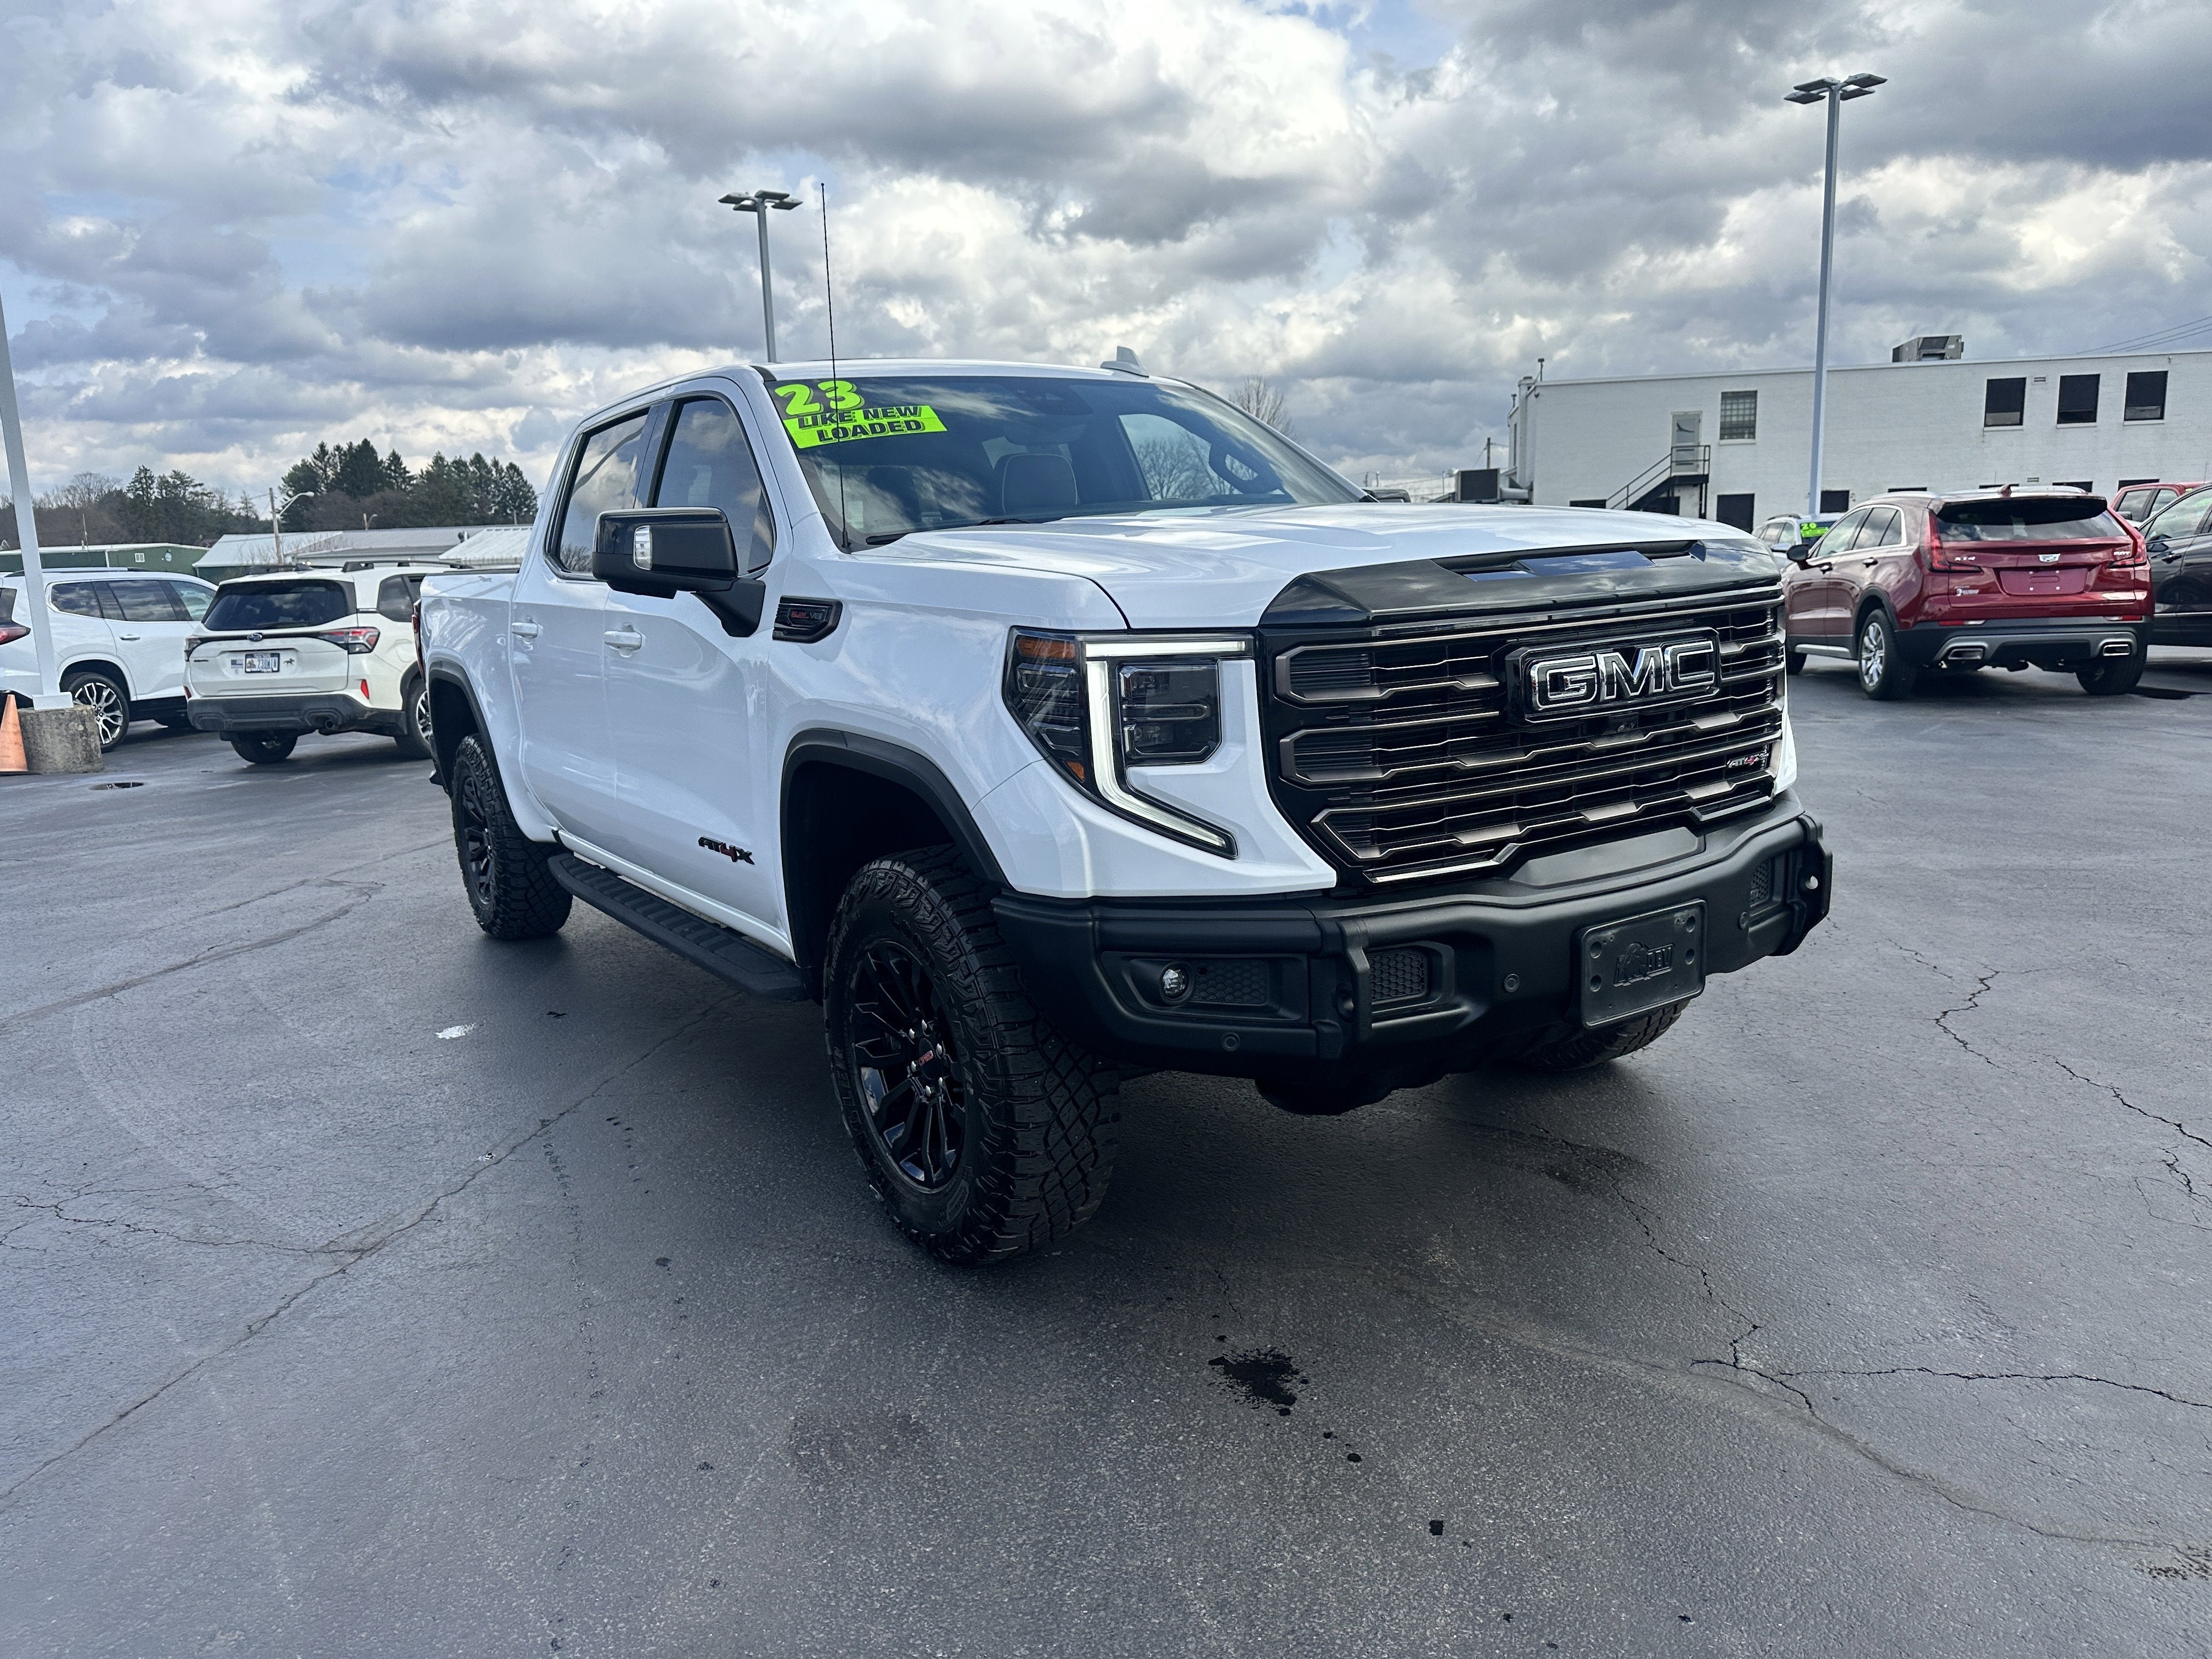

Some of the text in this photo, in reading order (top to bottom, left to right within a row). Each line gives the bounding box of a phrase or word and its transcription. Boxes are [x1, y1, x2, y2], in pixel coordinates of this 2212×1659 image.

[775, 380, 864, 415] 23
[798, 406, 922, 429] LIKE NEW
[817, 419, 925, 442] LOADED
[1530, 640, 1716, 710] GMC
